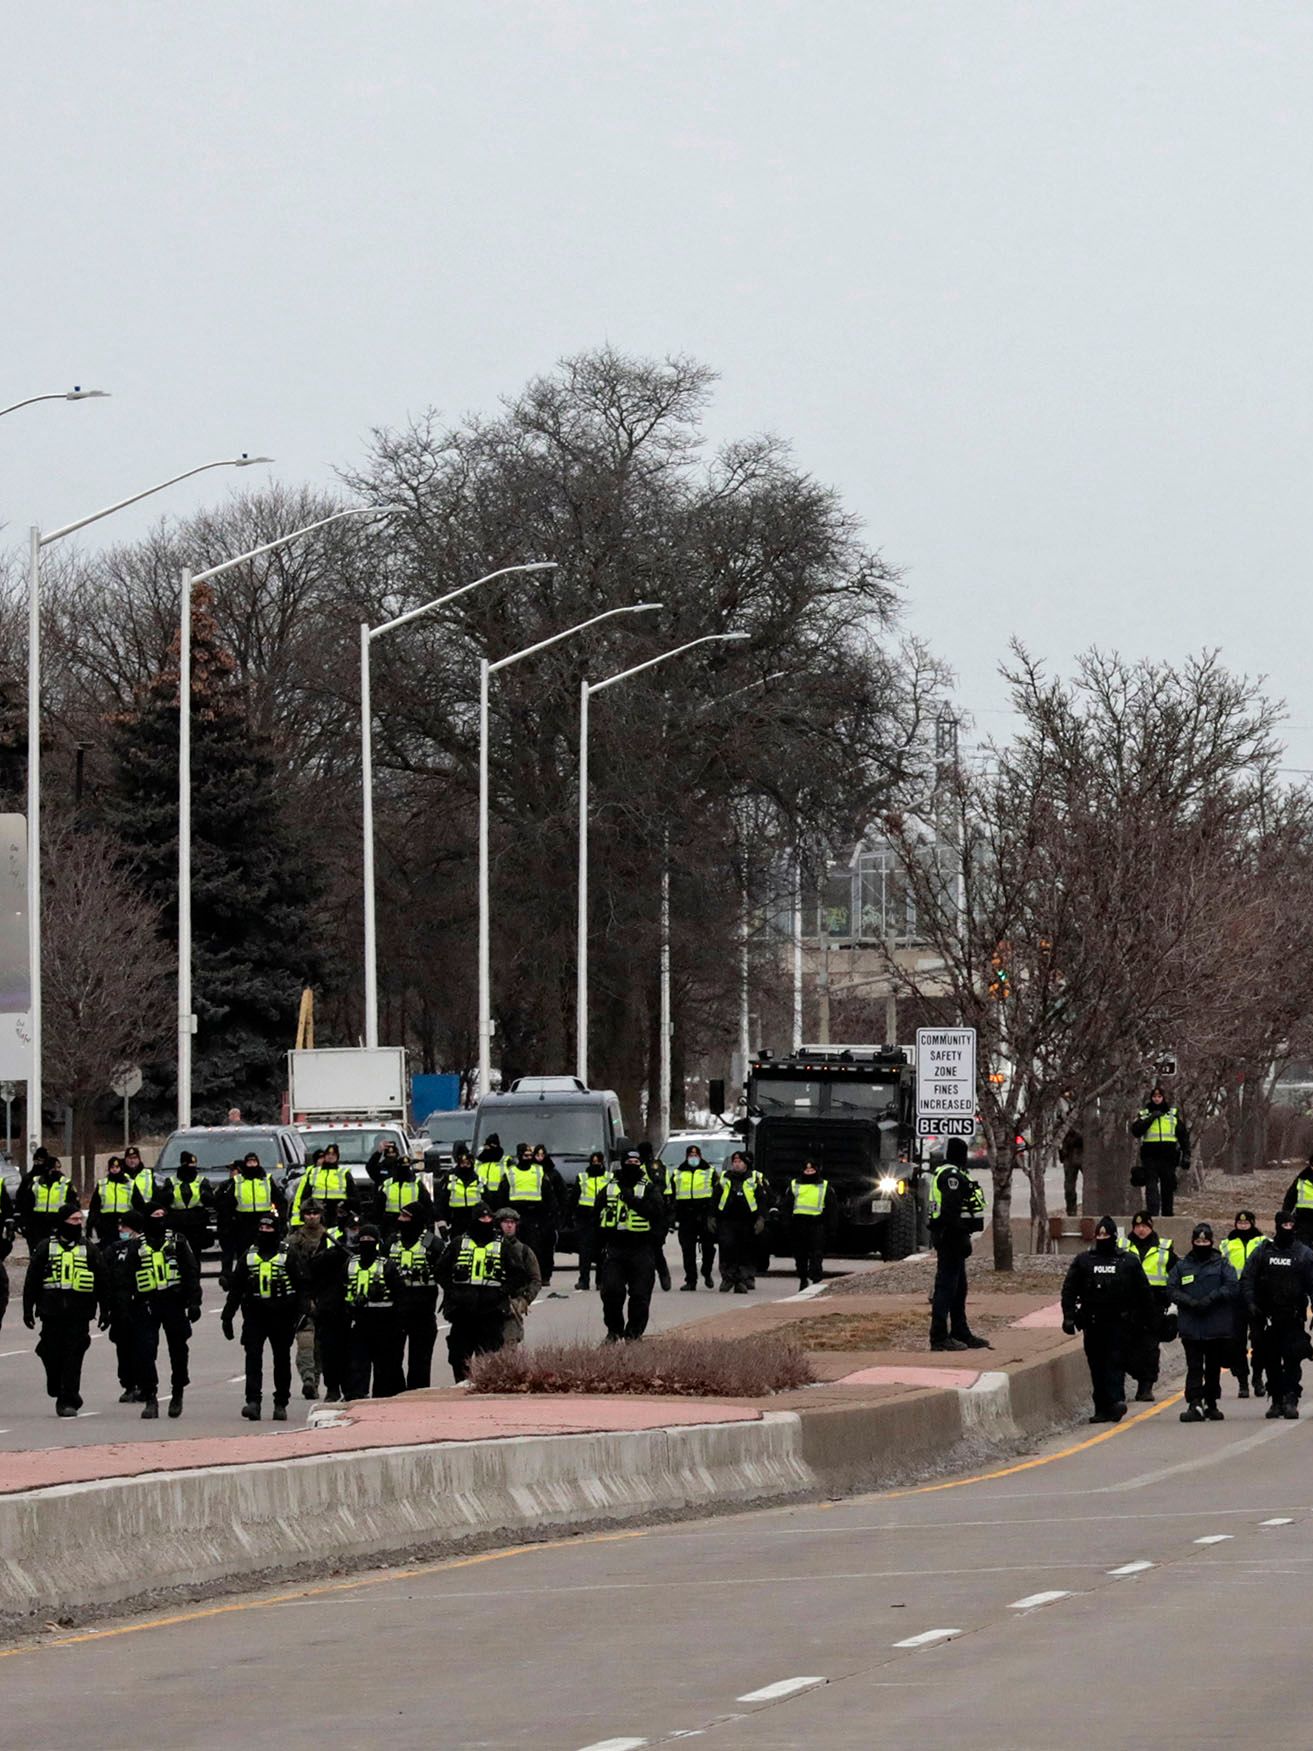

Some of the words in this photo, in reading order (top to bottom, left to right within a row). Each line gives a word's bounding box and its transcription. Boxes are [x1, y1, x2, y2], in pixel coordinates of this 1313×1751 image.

[920, 1035, 972, 1046] COMMUNITY
[930, 1050, 962, 1061] SAFETY
[934, 1066, 957, 1077] ZONE
[934, 1085, 959, 1095] FINES
[920, 1099, 972, 1110] INCREASED
[920, 1120, 972, 1133] BEGINS
[1268, 1257, 1292, 1266] POLICE
[1093, 1265, 1116, 1274] POLICE
